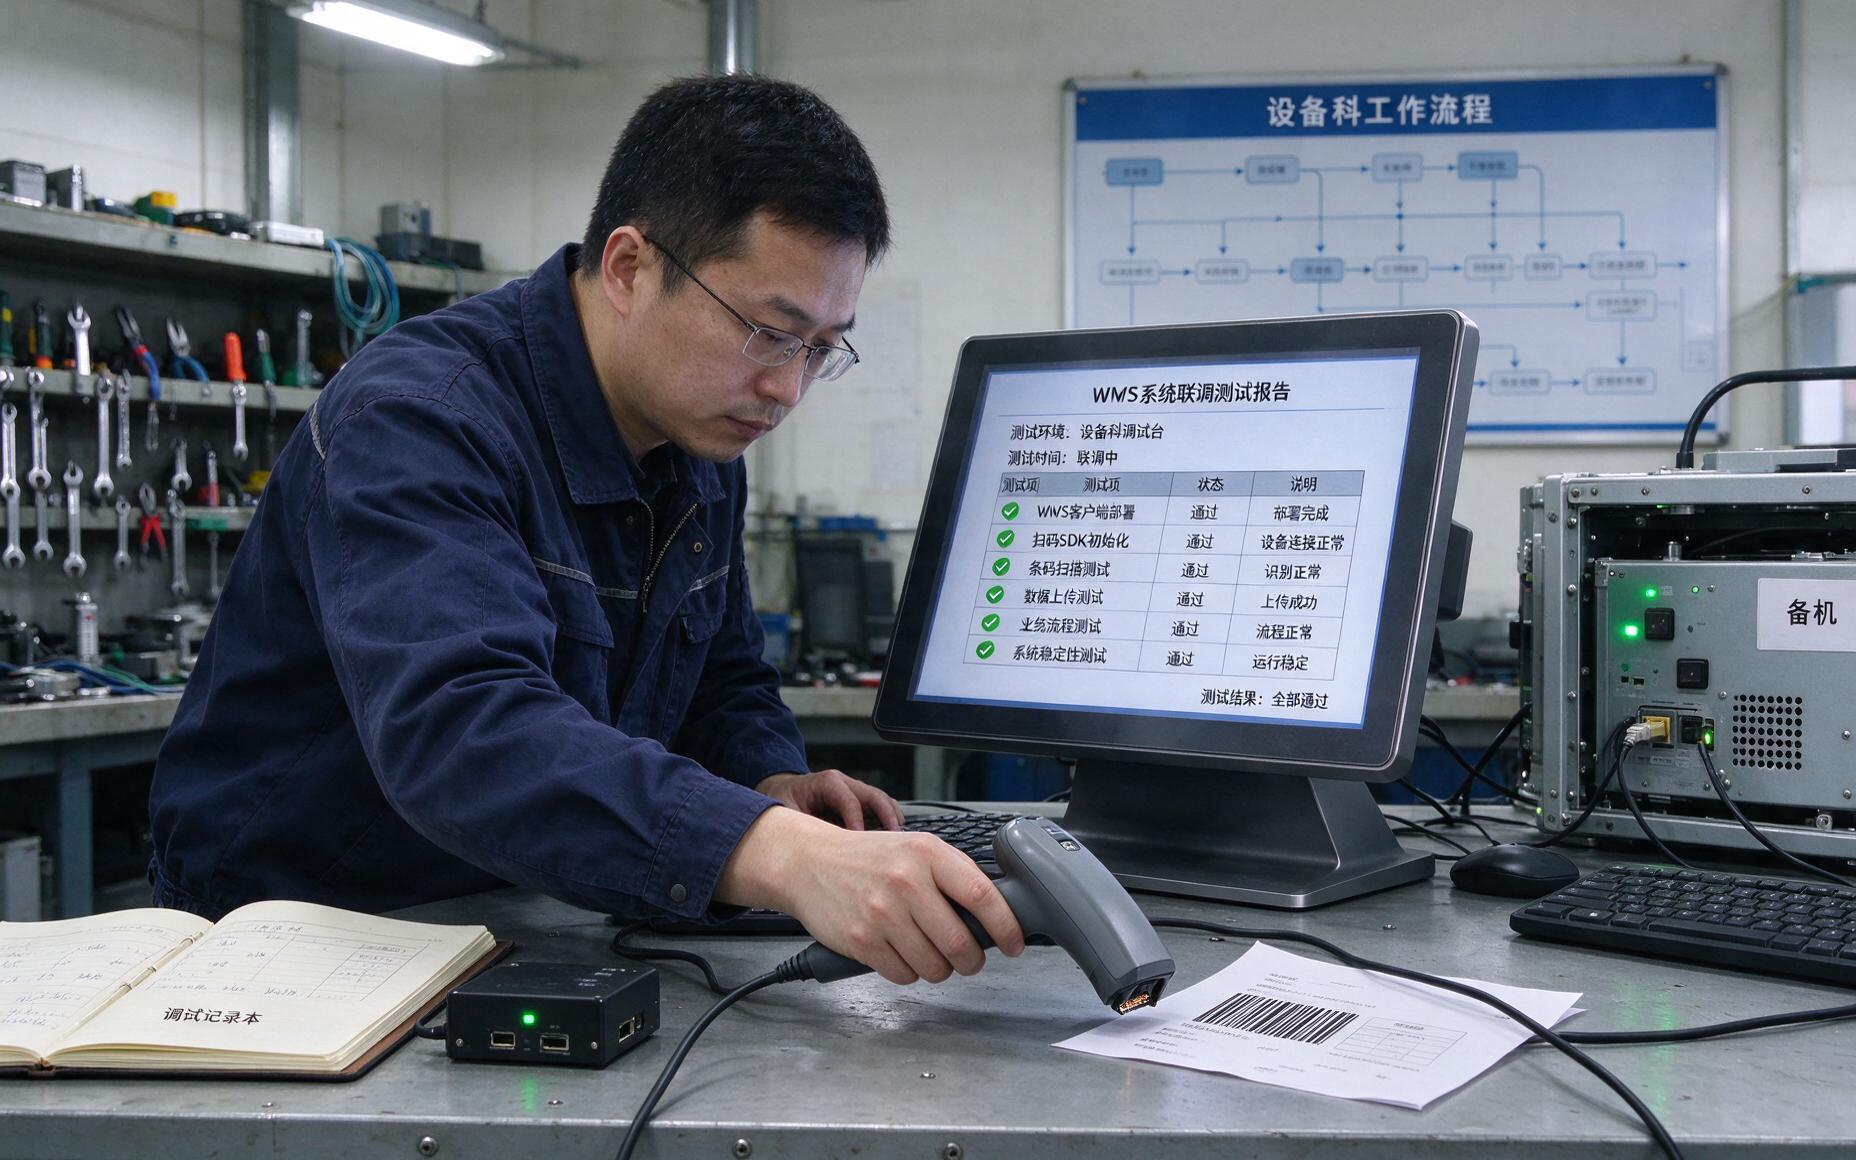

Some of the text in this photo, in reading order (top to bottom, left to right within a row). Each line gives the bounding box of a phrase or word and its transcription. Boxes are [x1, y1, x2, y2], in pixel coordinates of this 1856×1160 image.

[1266, 94, 1494, 128] 设备科工作流程
[1093, 381, 1291, 404] WMS系统联调测试报告
[1002, 476, 1040, 493] 测试项
[1082, 476, 1121, 493] 测试项
[1198, 476, 1224, 492] 状态
[1290, 475, 1317, 492] 说明
[1190, 504, 1218, 520] 通过
[1032, 532, 1129, 548] 扫码SDK初始化
[1186, 533, 1214, 549] 通过
[1261, 534, 1345, 551] 设备连接正常
[1181, 562, 1209, 578] 通过
[1265, 563, 1322, 580] 识别正常
[1176, 591, 1204, 607] 通过
[1261, 594, 1318, 610] 上传成功
[1787, 598, 1837, 626] 备机
[1171, 620, 1199, 637] 通过
[1256, 623, 1313, 640] 流程正常
[1013, 645, 1107, 663] 系统稳定性测试
[1165, 650, 1194, 667] 通过
[1252, 654, 1309, 671] 运行稳定
[163, 1007, 263, 1025] 调试记录本
